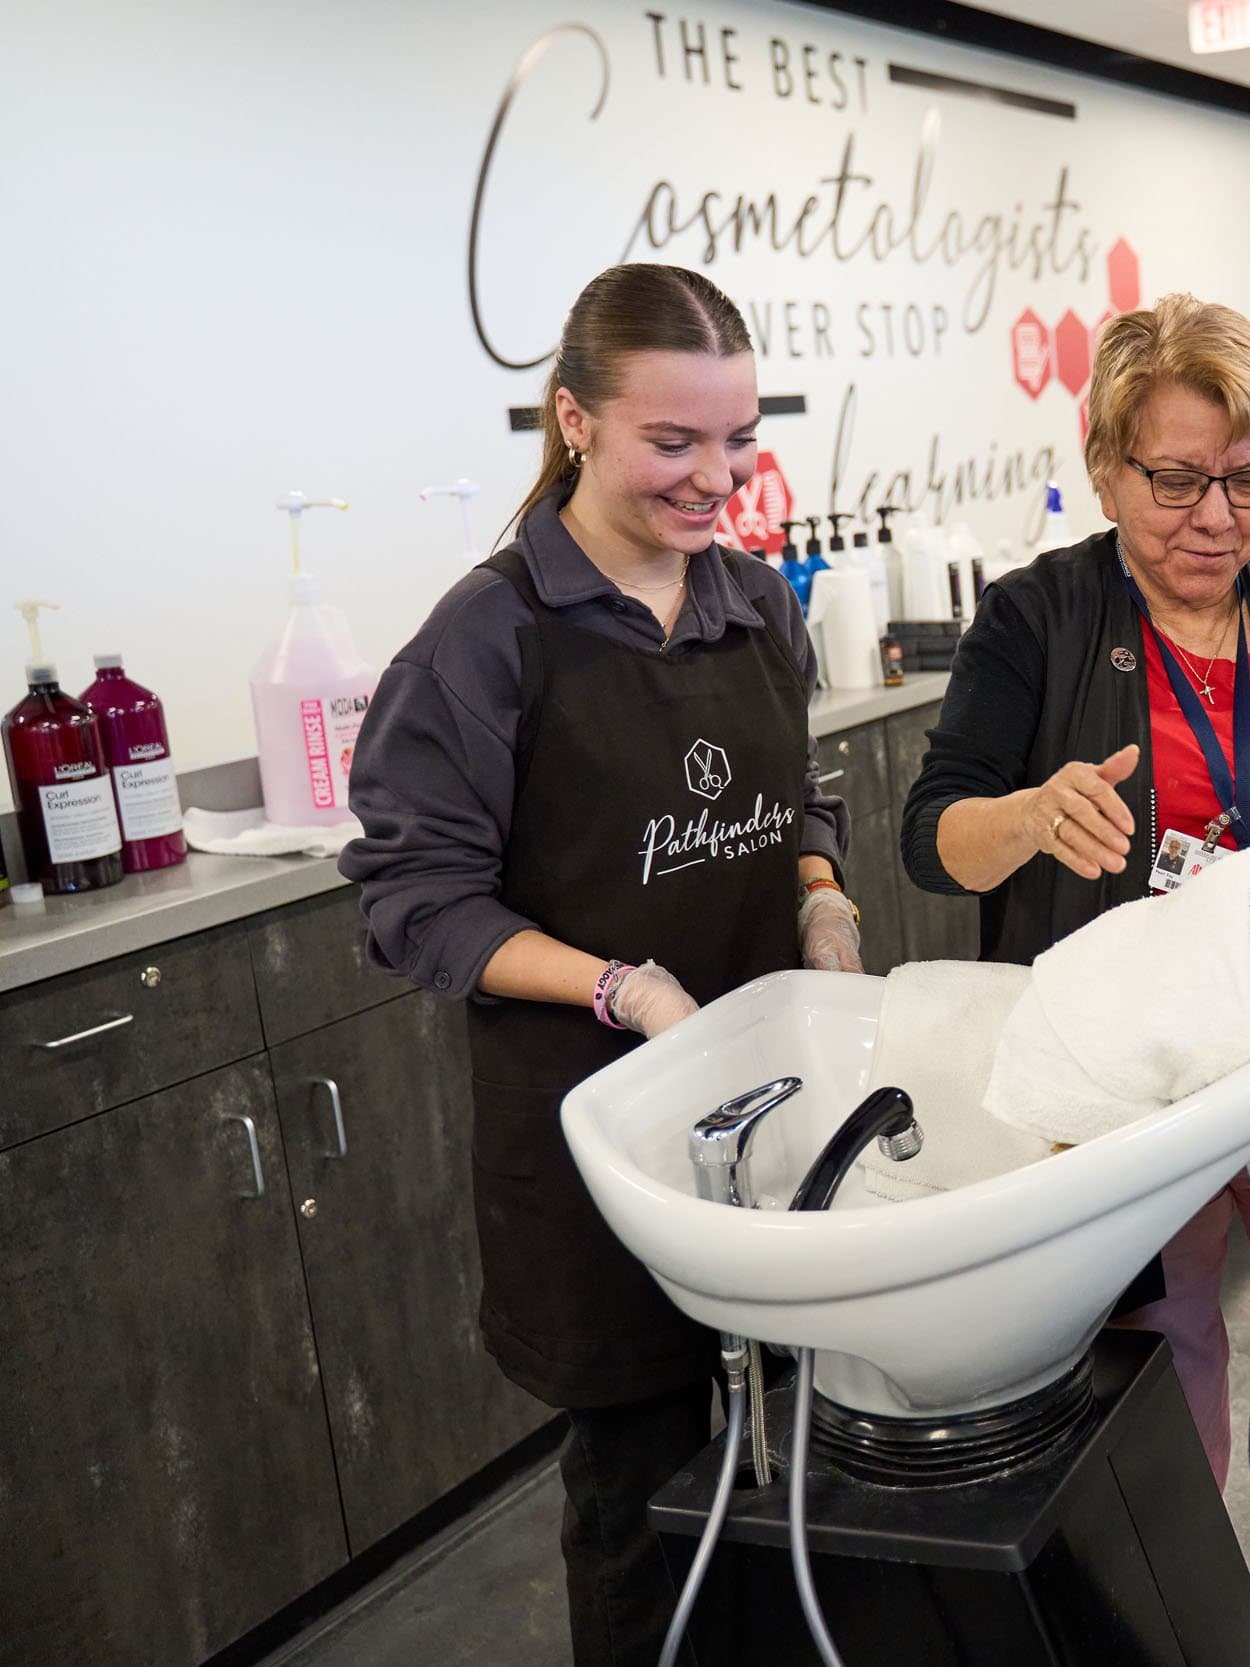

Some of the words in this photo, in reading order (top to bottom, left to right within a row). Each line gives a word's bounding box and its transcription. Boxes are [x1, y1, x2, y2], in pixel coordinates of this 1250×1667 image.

[643, 12, 742, 92] THE
[771, 37, 871, 112] BEST
[466, 22, 1099, 371] Cosmetologists
[750, 301, 835, 357] VER
[857, 301, 949, 357] STOP
[829, 383, 1064, 547] learning
[304, 714, 326, 757] RINSE
[45, 789, 70, 801] Curl
[120, 770, 143, 781] Curl
[121, 774, 169, 790] Expression
[310, 757, 333, 806] CREAM
[47, 795, 102, 811] Expression
[638, 793, 795, 885] Pathfinders
[724, 830, 783, 859] SALON
